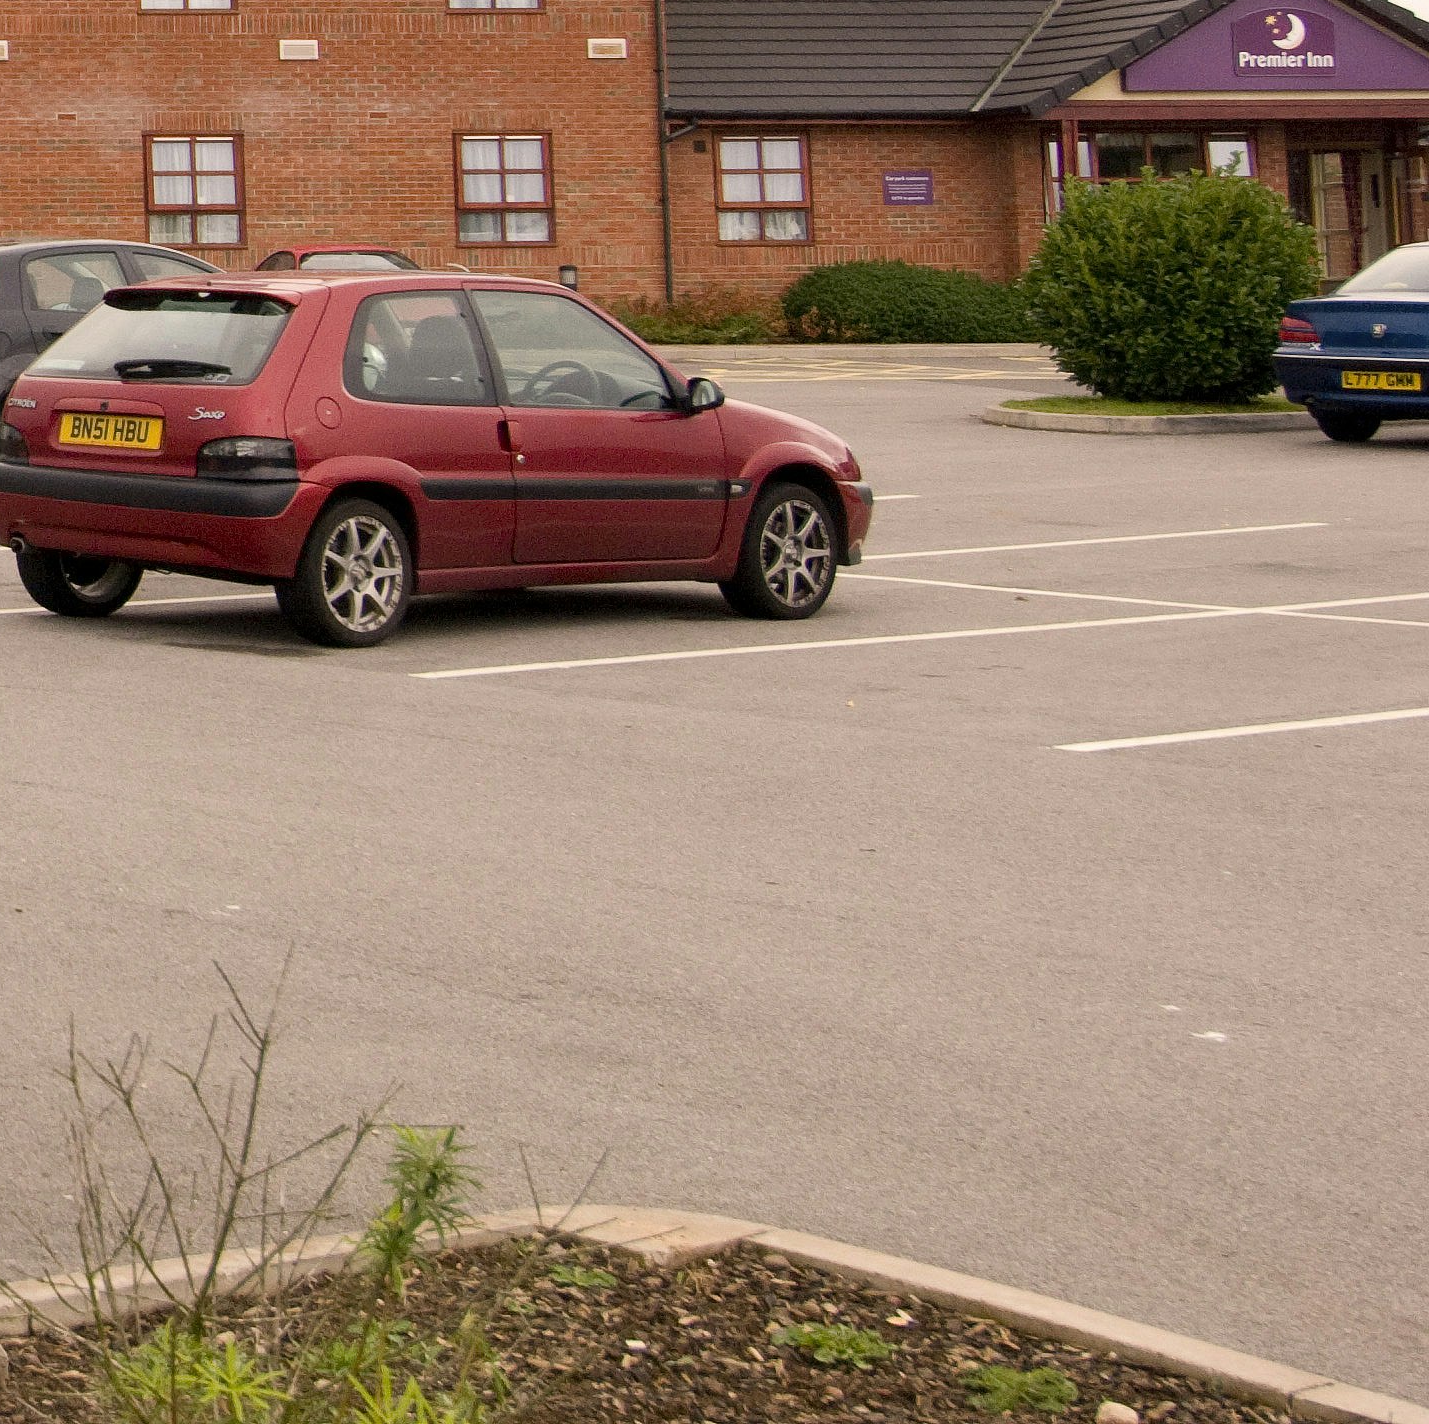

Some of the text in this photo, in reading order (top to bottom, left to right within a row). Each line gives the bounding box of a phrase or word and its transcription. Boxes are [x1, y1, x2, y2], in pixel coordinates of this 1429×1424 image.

[1238, 50, 1335, 68] Premier Inn
[187, 406, 226, 421] Saxo
[70, 416, 150, 443] BN51 HBU
